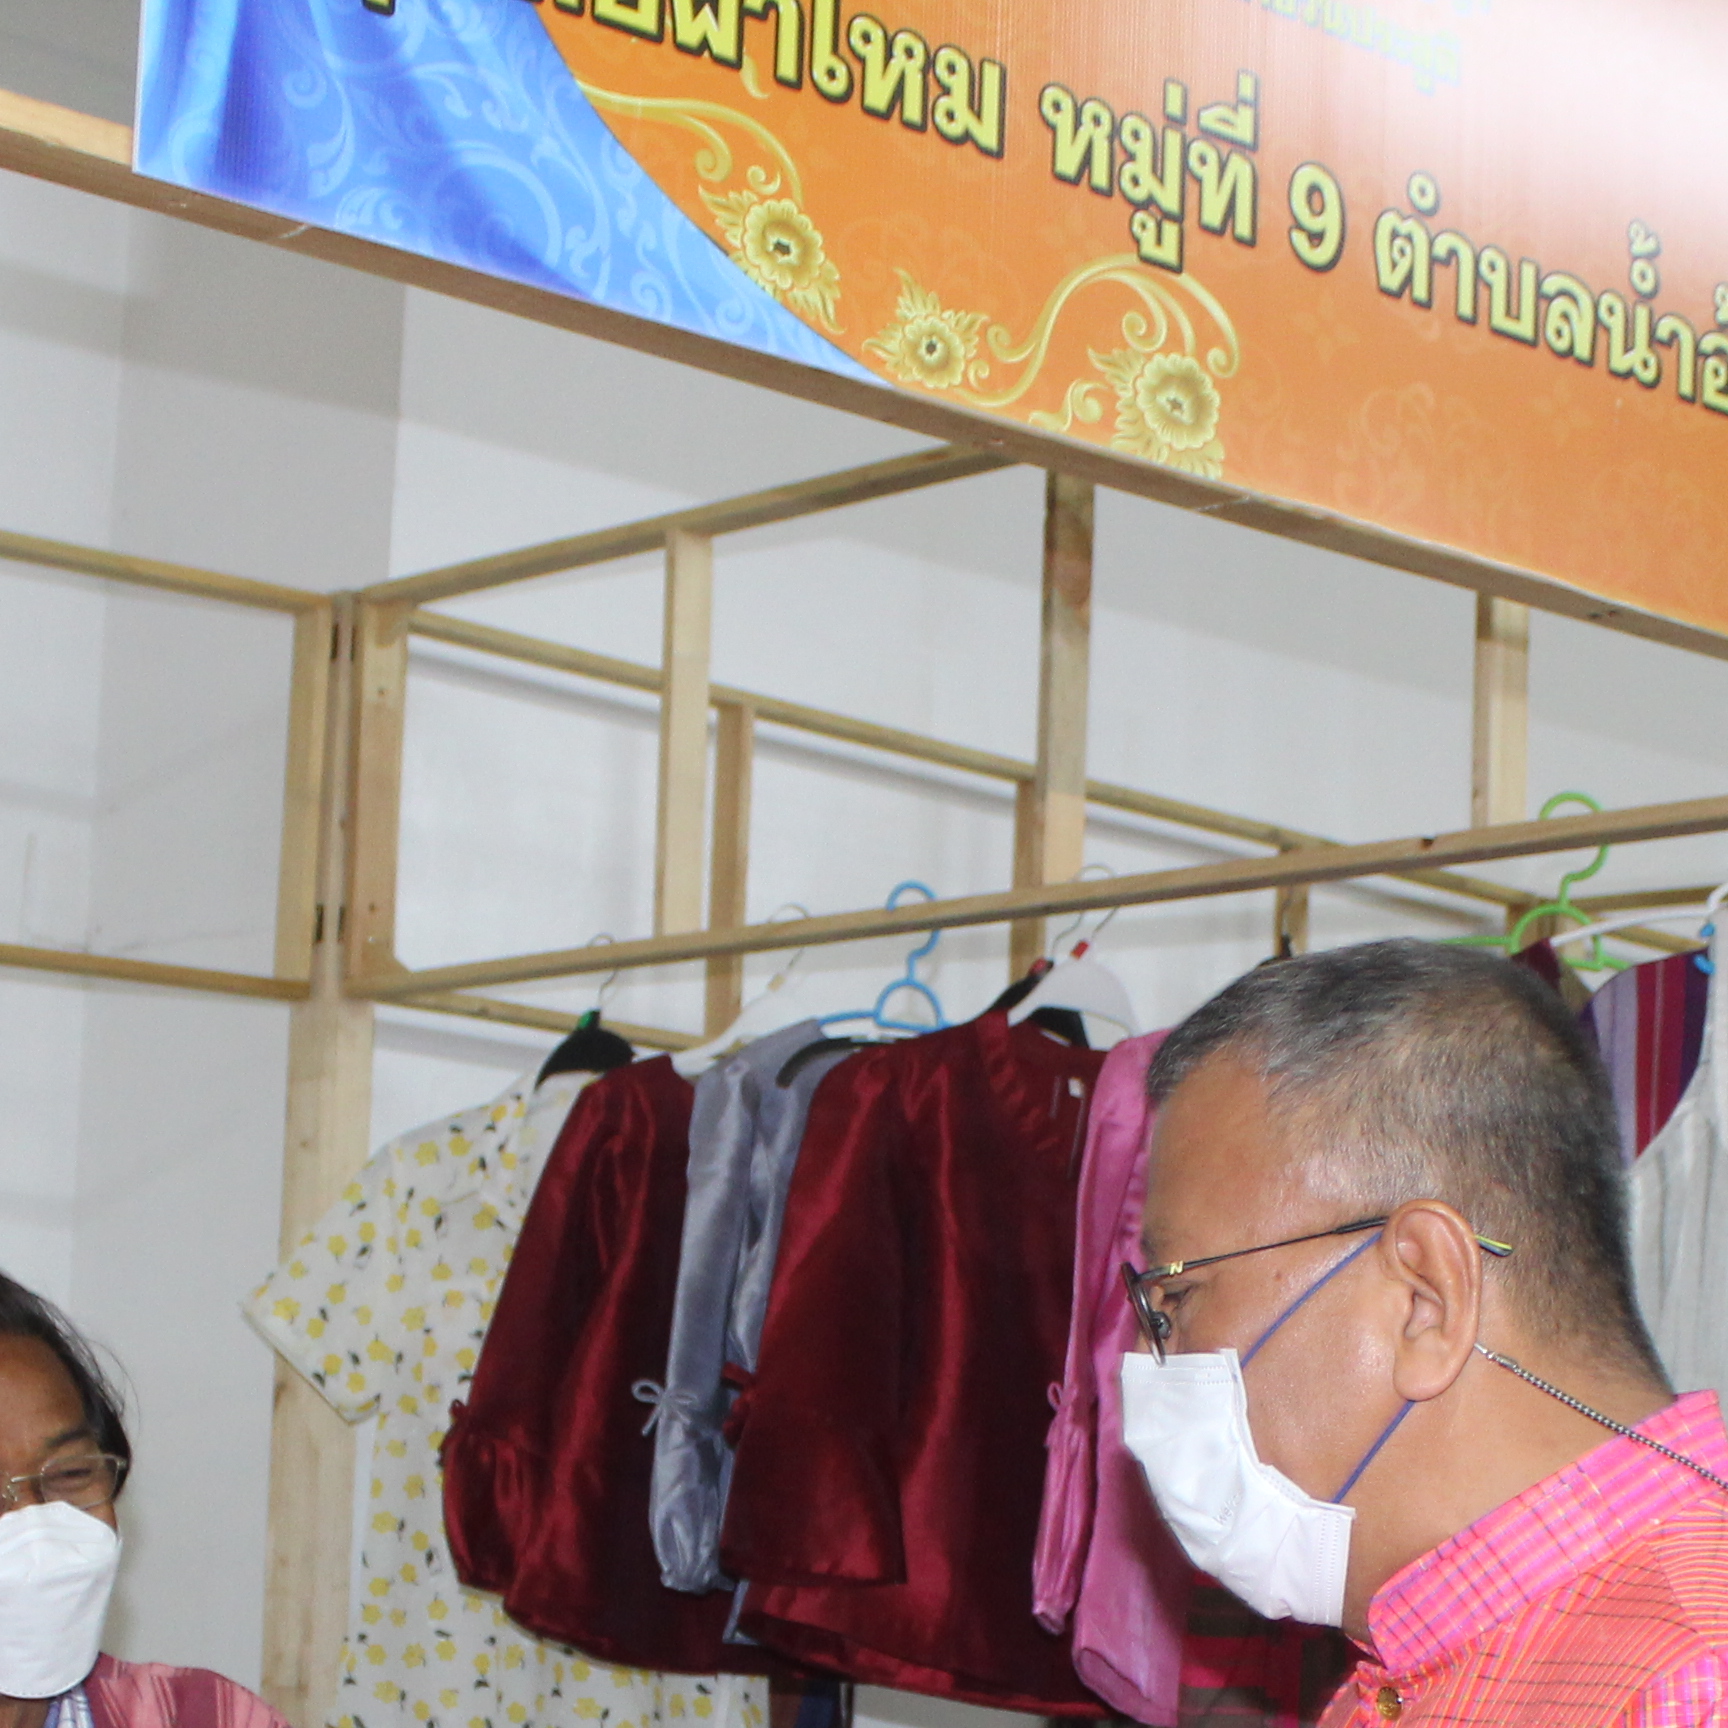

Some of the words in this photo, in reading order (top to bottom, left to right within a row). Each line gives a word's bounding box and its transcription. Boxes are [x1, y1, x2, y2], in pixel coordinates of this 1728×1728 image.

[1039, 70, 1259, 273] หมู่ที่
[1288, 162, 1345, 271] 9
